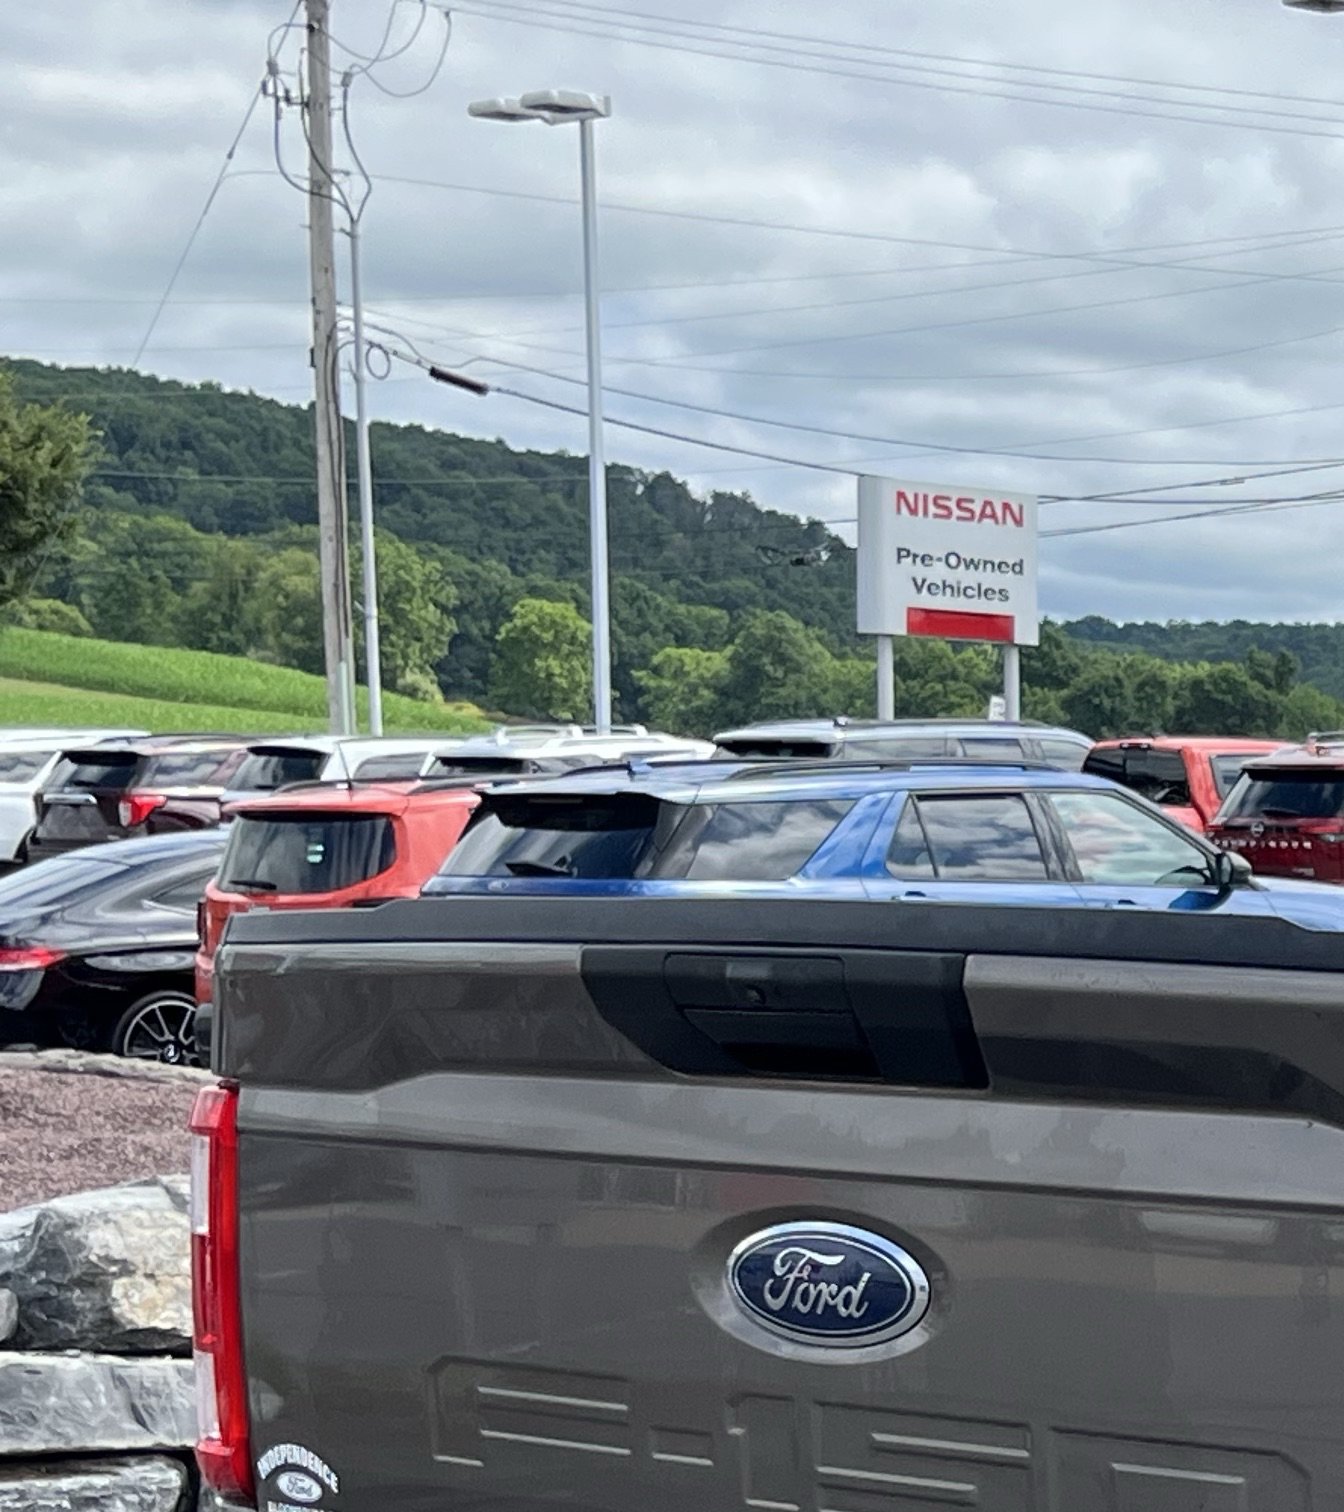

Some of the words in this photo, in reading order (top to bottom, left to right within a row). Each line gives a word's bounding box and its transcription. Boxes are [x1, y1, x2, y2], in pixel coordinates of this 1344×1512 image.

[896, 490, 1024, 527] NISSAN
[896, 547, 1024, 575] Pre-Owned
[912, 577, 1010, 602] Vehicles
[764, 1247, 872, 1319] Ford
